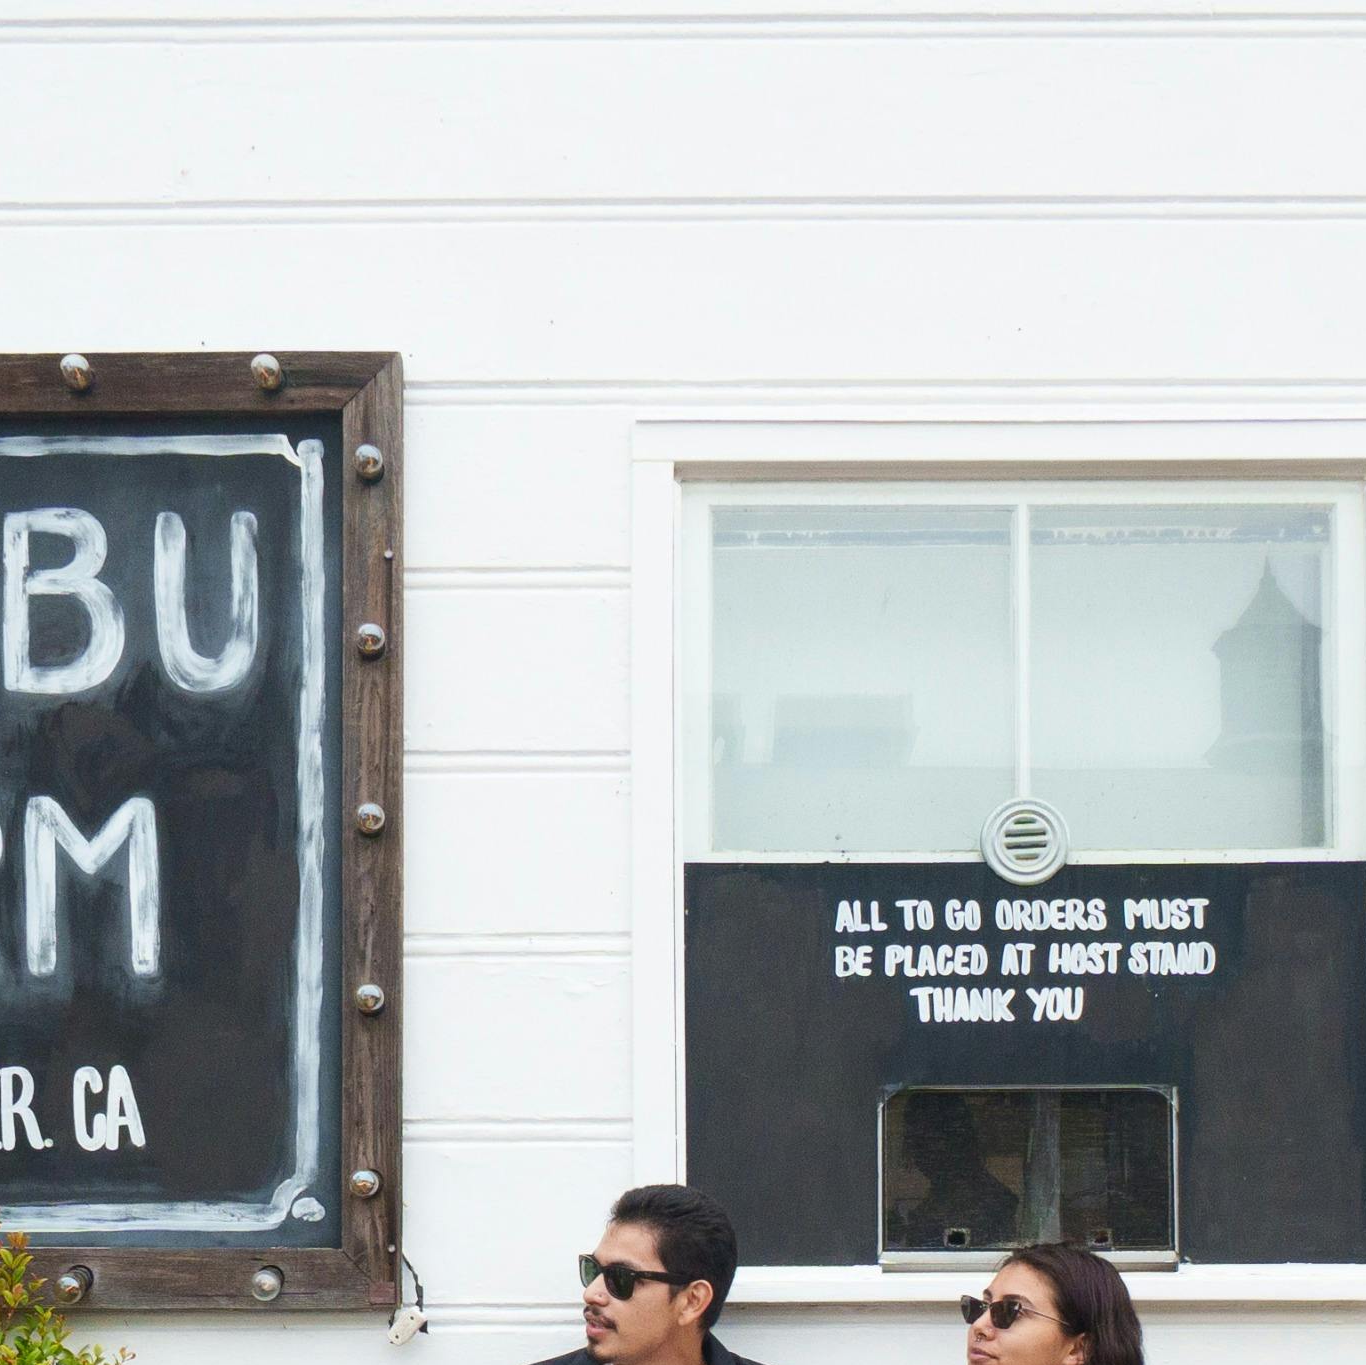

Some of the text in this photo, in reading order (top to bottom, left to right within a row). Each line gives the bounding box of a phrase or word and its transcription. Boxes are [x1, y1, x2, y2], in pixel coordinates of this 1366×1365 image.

[835, 898, 1209, 932] ALL TO GO ORDERS MUST
[836, 942, 1215, 977] BE PLACED AT HOST STAND
[910, 987, 1083, 1022] THANK YOU
[73, 1065, 145, 1151] CA
